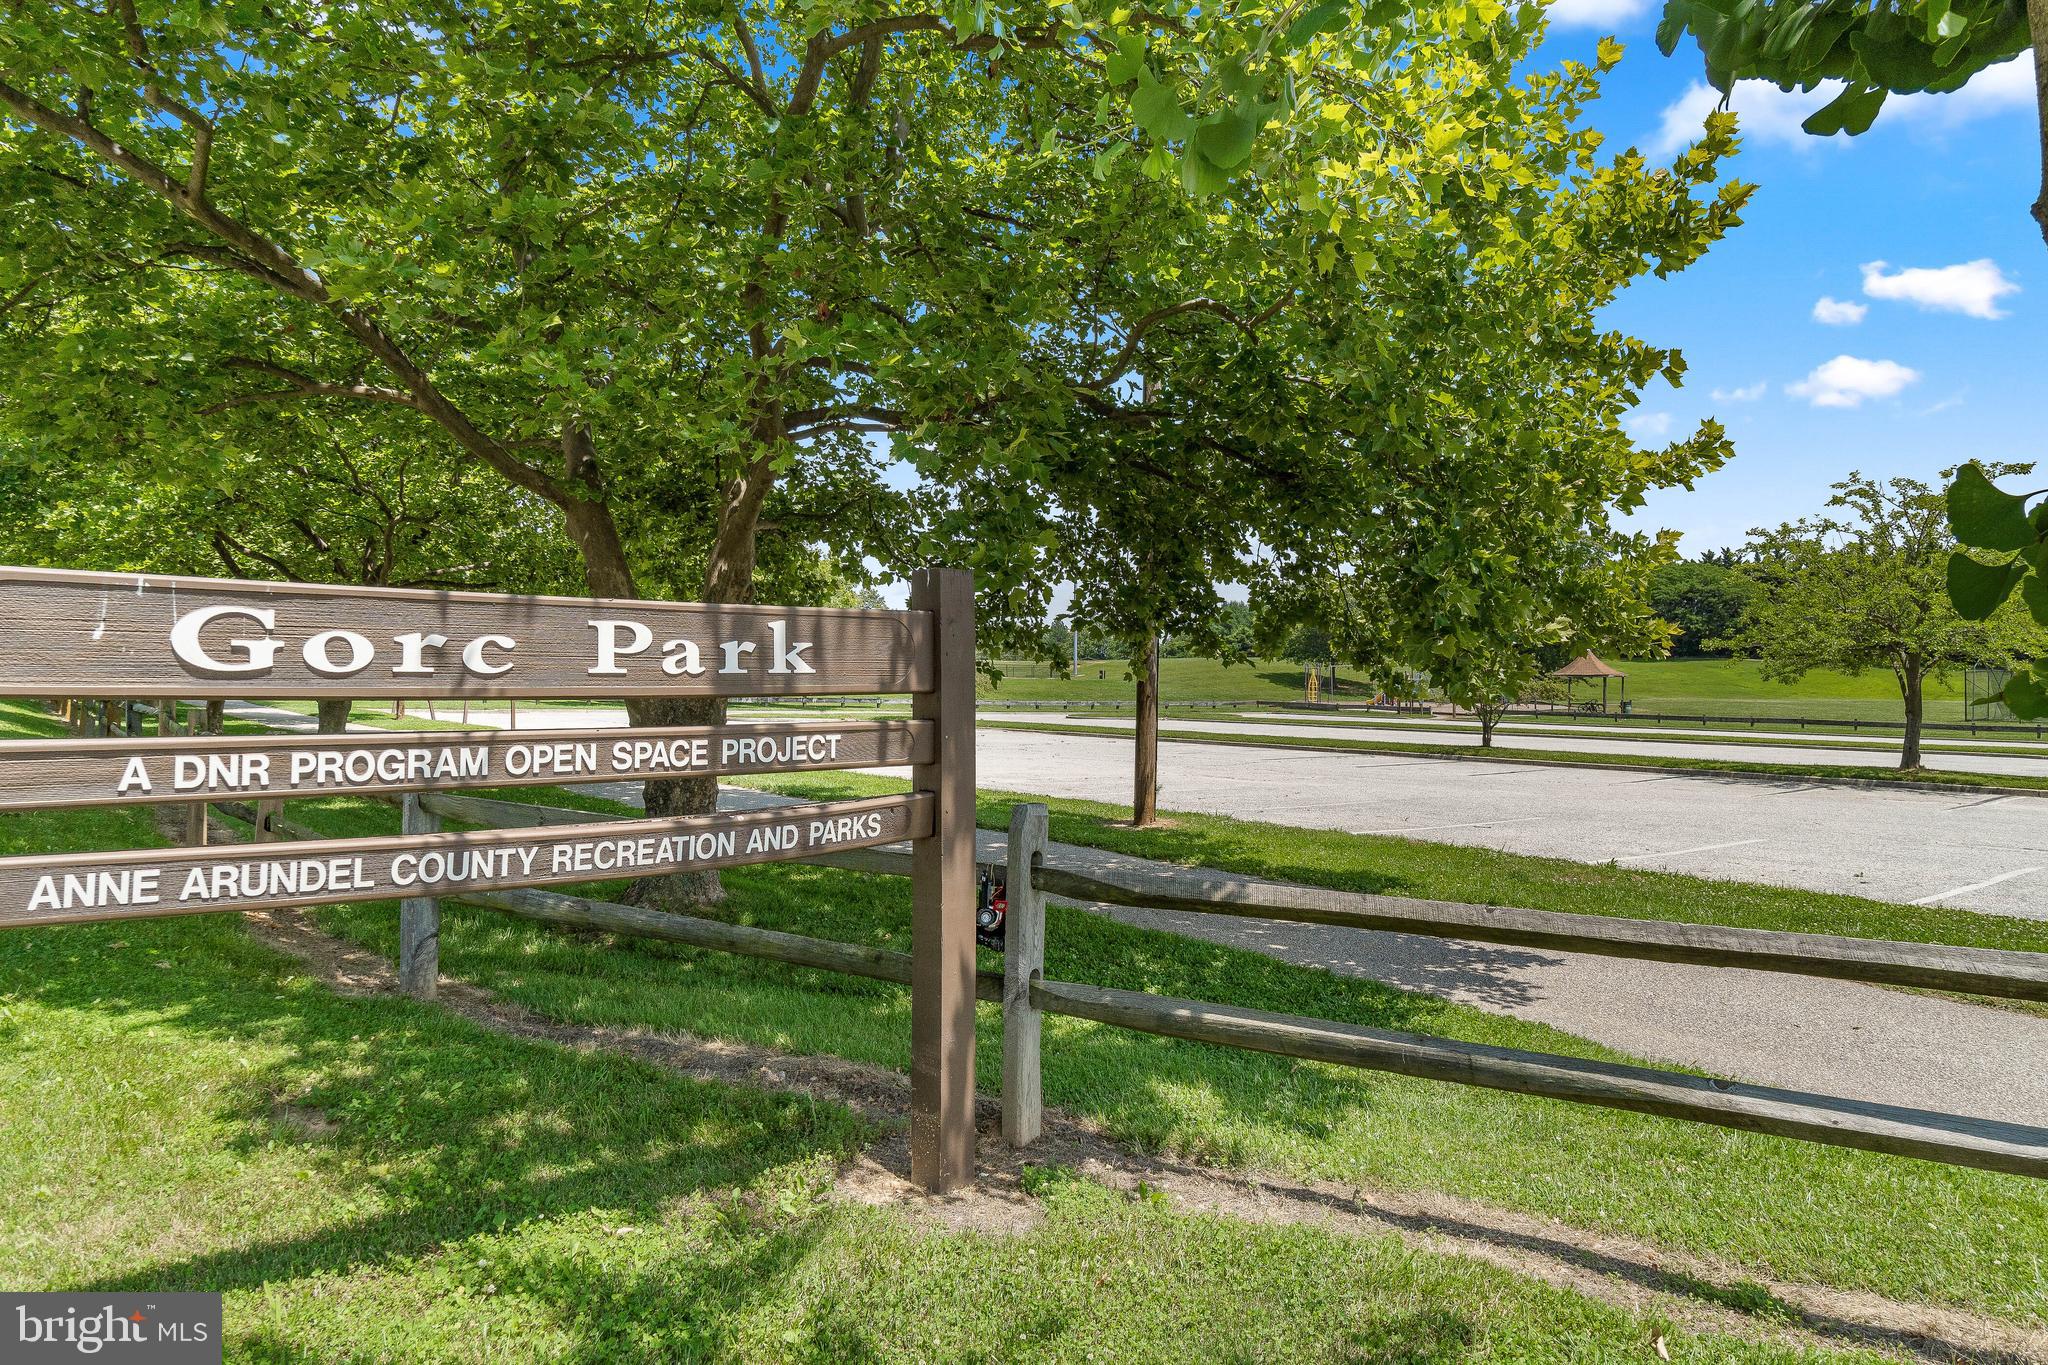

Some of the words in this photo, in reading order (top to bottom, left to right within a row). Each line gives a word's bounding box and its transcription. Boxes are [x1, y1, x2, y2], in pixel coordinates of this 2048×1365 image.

[170, 605, 517, 676] Gorc
[587, 619, 817, 676] Park
[117, 757, 153, 792] A
[174, 753, 270, 790] DNR
[290, 746, 489, 785] PROGRAM
[505, 743, 598, 776] OPEN
[611, 739, 709, 771] SPACE
[721, 734, 841, 766] PROJECT
[27, 868, 161, 911] ANNE
[179, 857, 375, 902] ARUNDEL
[391, 846, 538, 886] COUNTY
[552, 830, 736, 873] RECREATION
[745, 824, 799, 855] AND
[809, 814, 882, 847] PARKS
